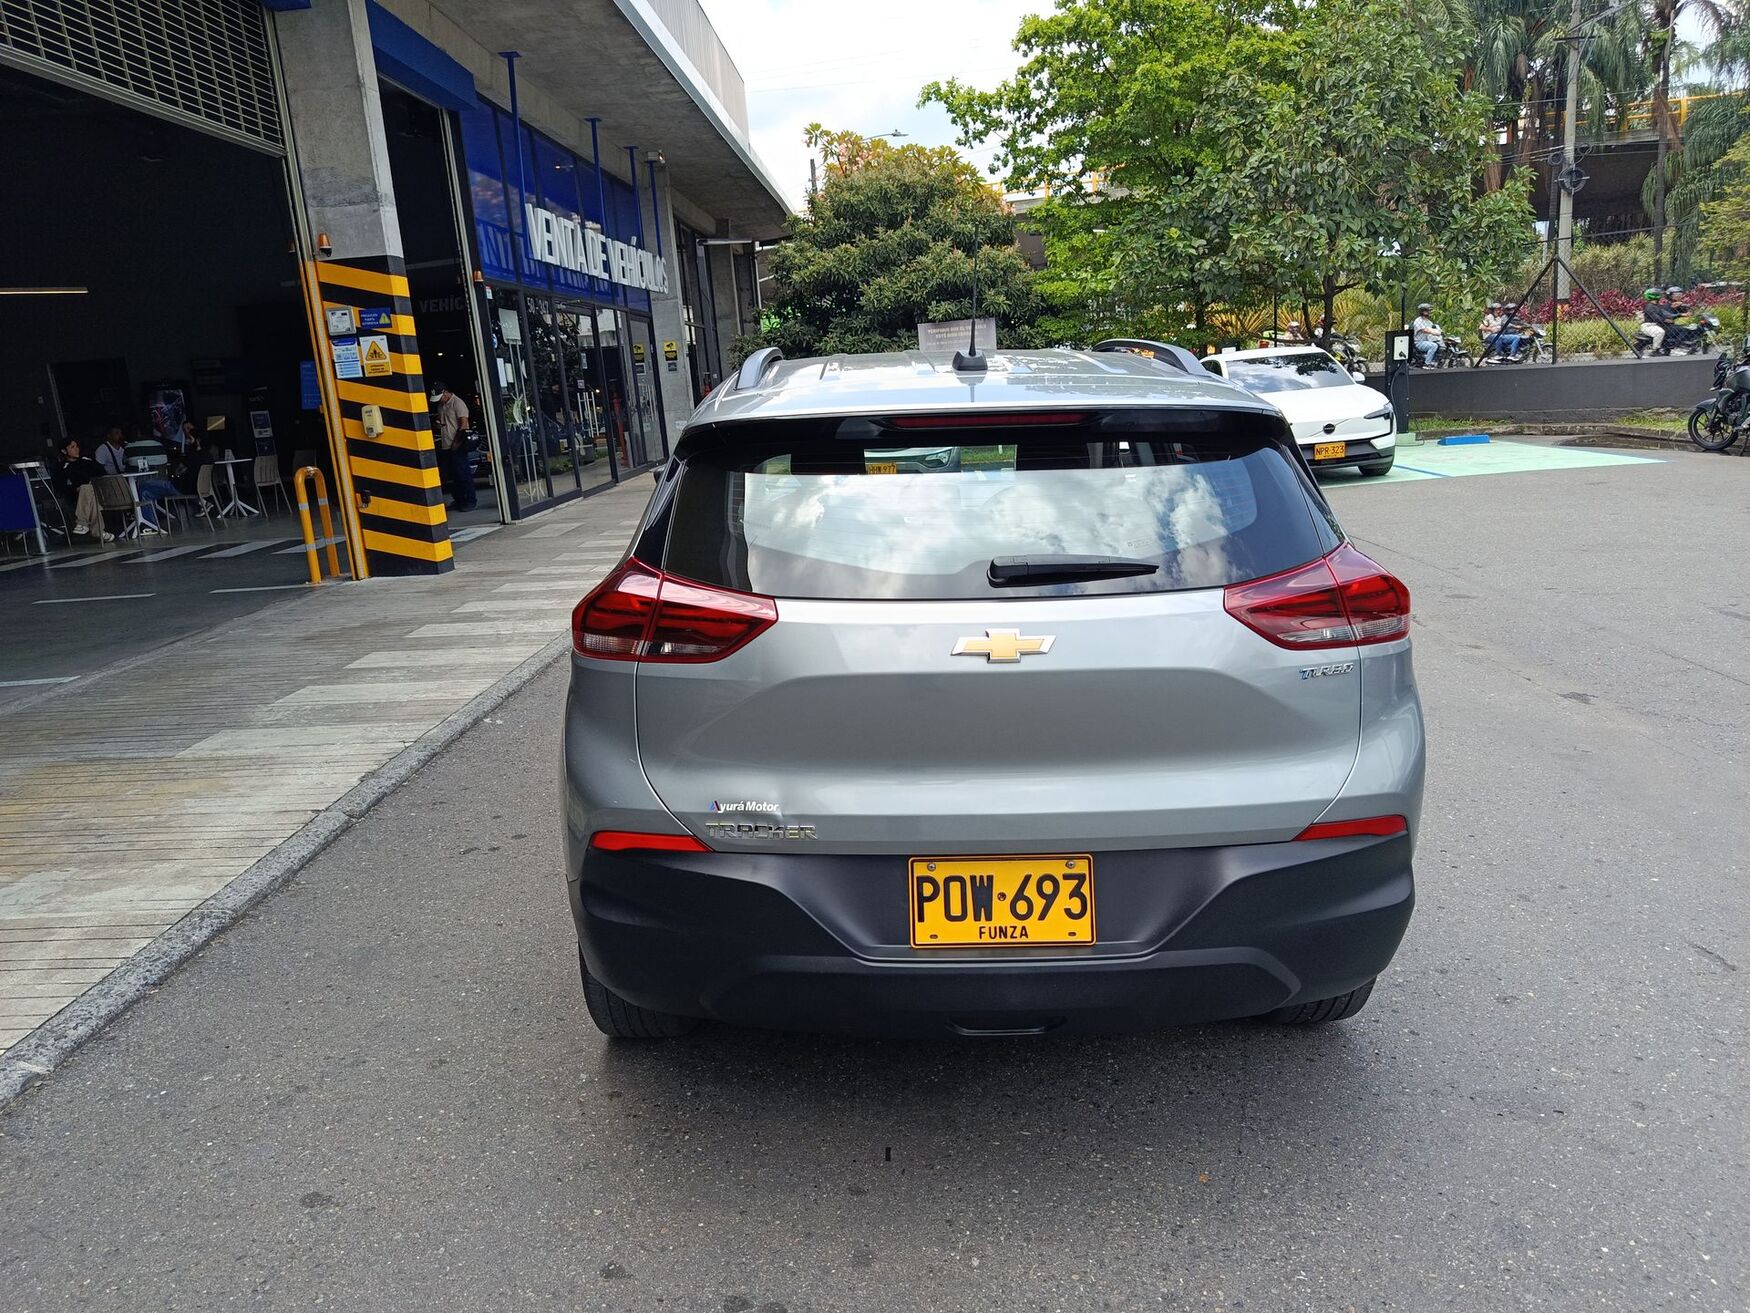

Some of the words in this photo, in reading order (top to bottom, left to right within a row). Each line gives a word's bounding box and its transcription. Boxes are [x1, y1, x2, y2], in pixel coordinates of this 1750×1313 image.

[524, 203, 589, 275] VENTA
[584, 228, 610, 280] DE
[1299, 662, 1354, 680] TURBO
[709, 800, 745, 813] Ayurá
[745, 801, 779, 812] Motor
[705, 822, 818, 840] TRACKER
[978, 925, 1029, 940] FUNZA
